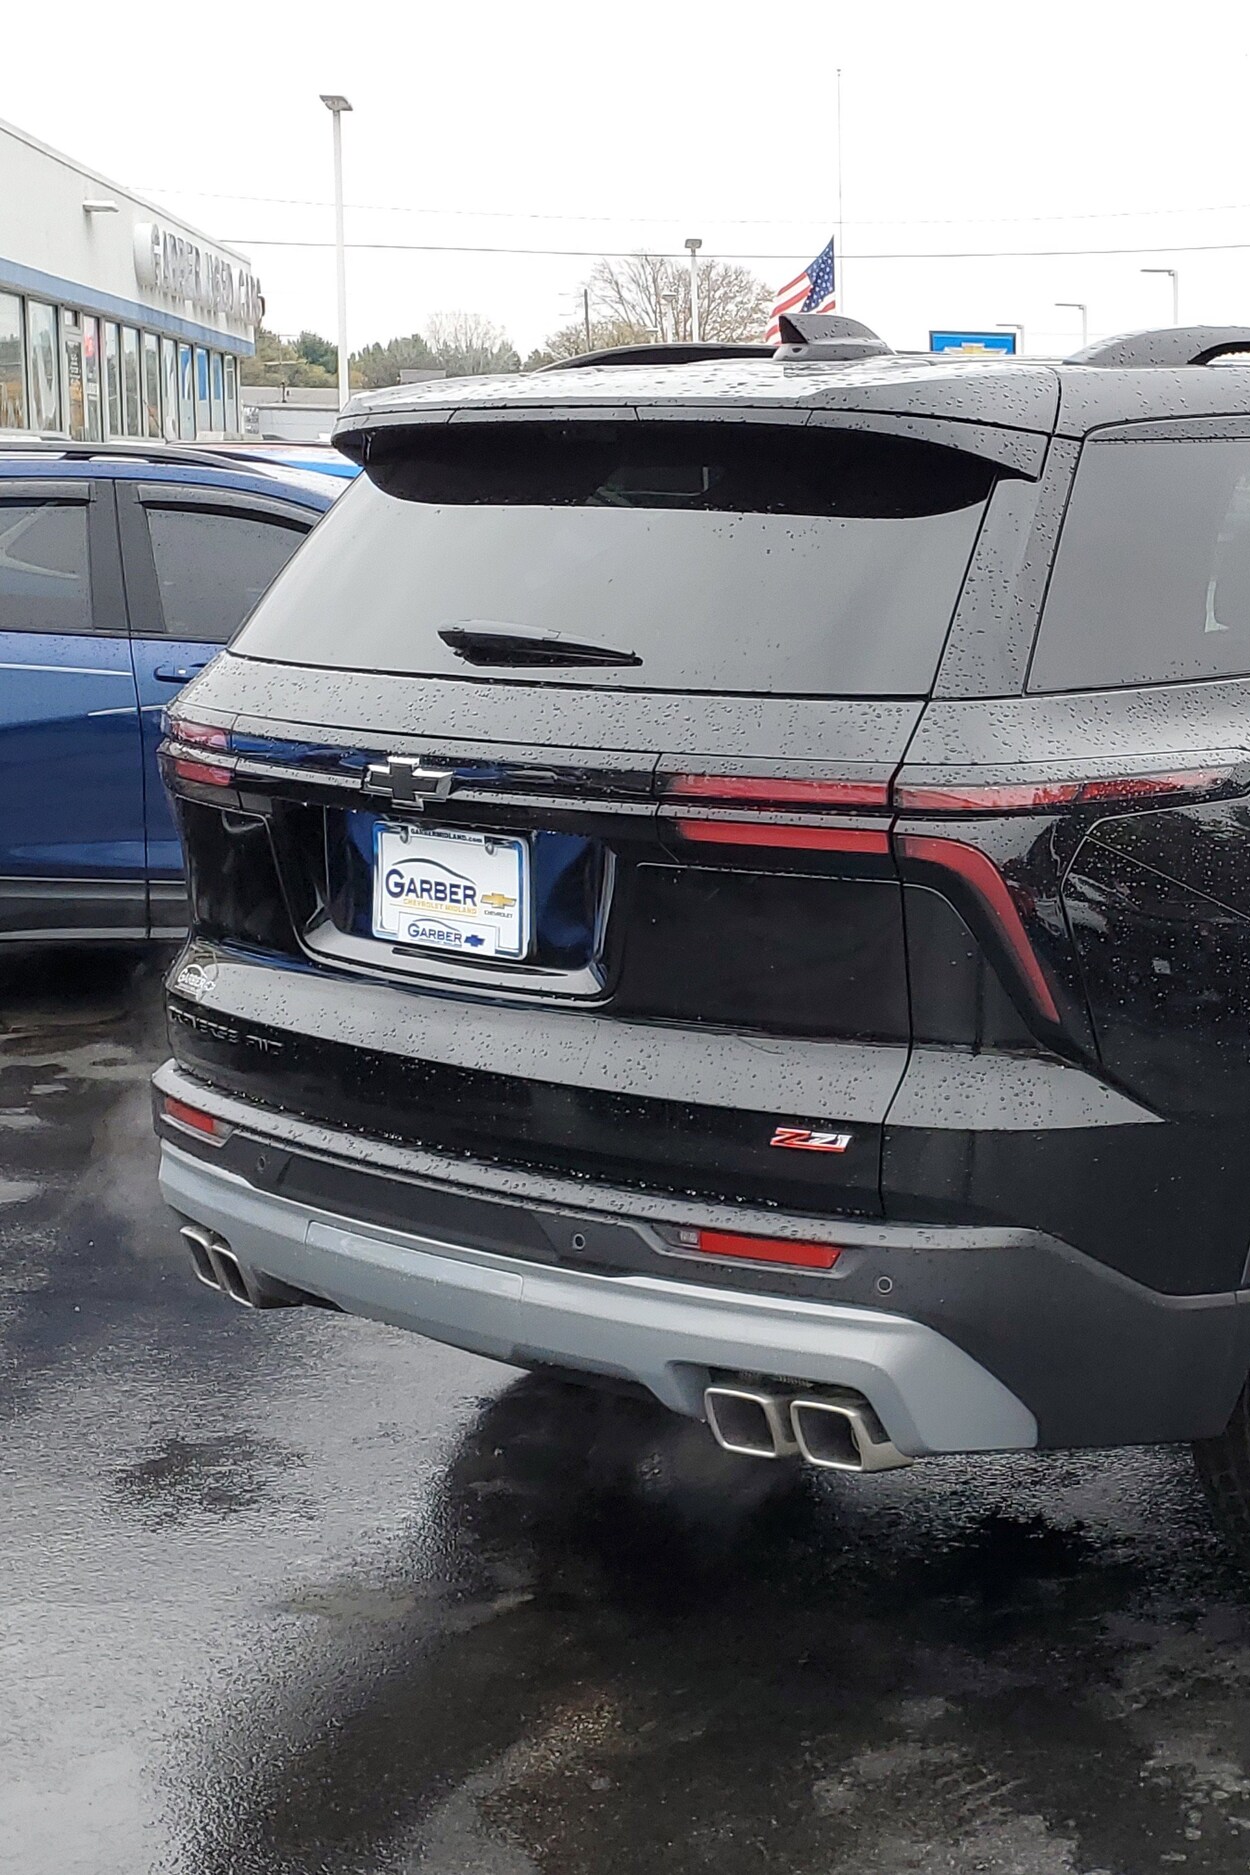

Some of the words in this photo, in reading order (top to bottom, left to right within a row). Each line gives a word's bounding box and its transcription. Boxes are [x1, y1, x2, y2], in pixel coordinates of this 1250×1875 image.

[385, 868, 478, 907] GARBER
[403, 898, 443, 910] CHEVROLET
[445, 904, 478, 915] MIDLAND
[484, 909, 513, 918] CHEVROLET
[407, 923, 463, 944] GARBER
[770, 1127, 853, 1153] Z71
